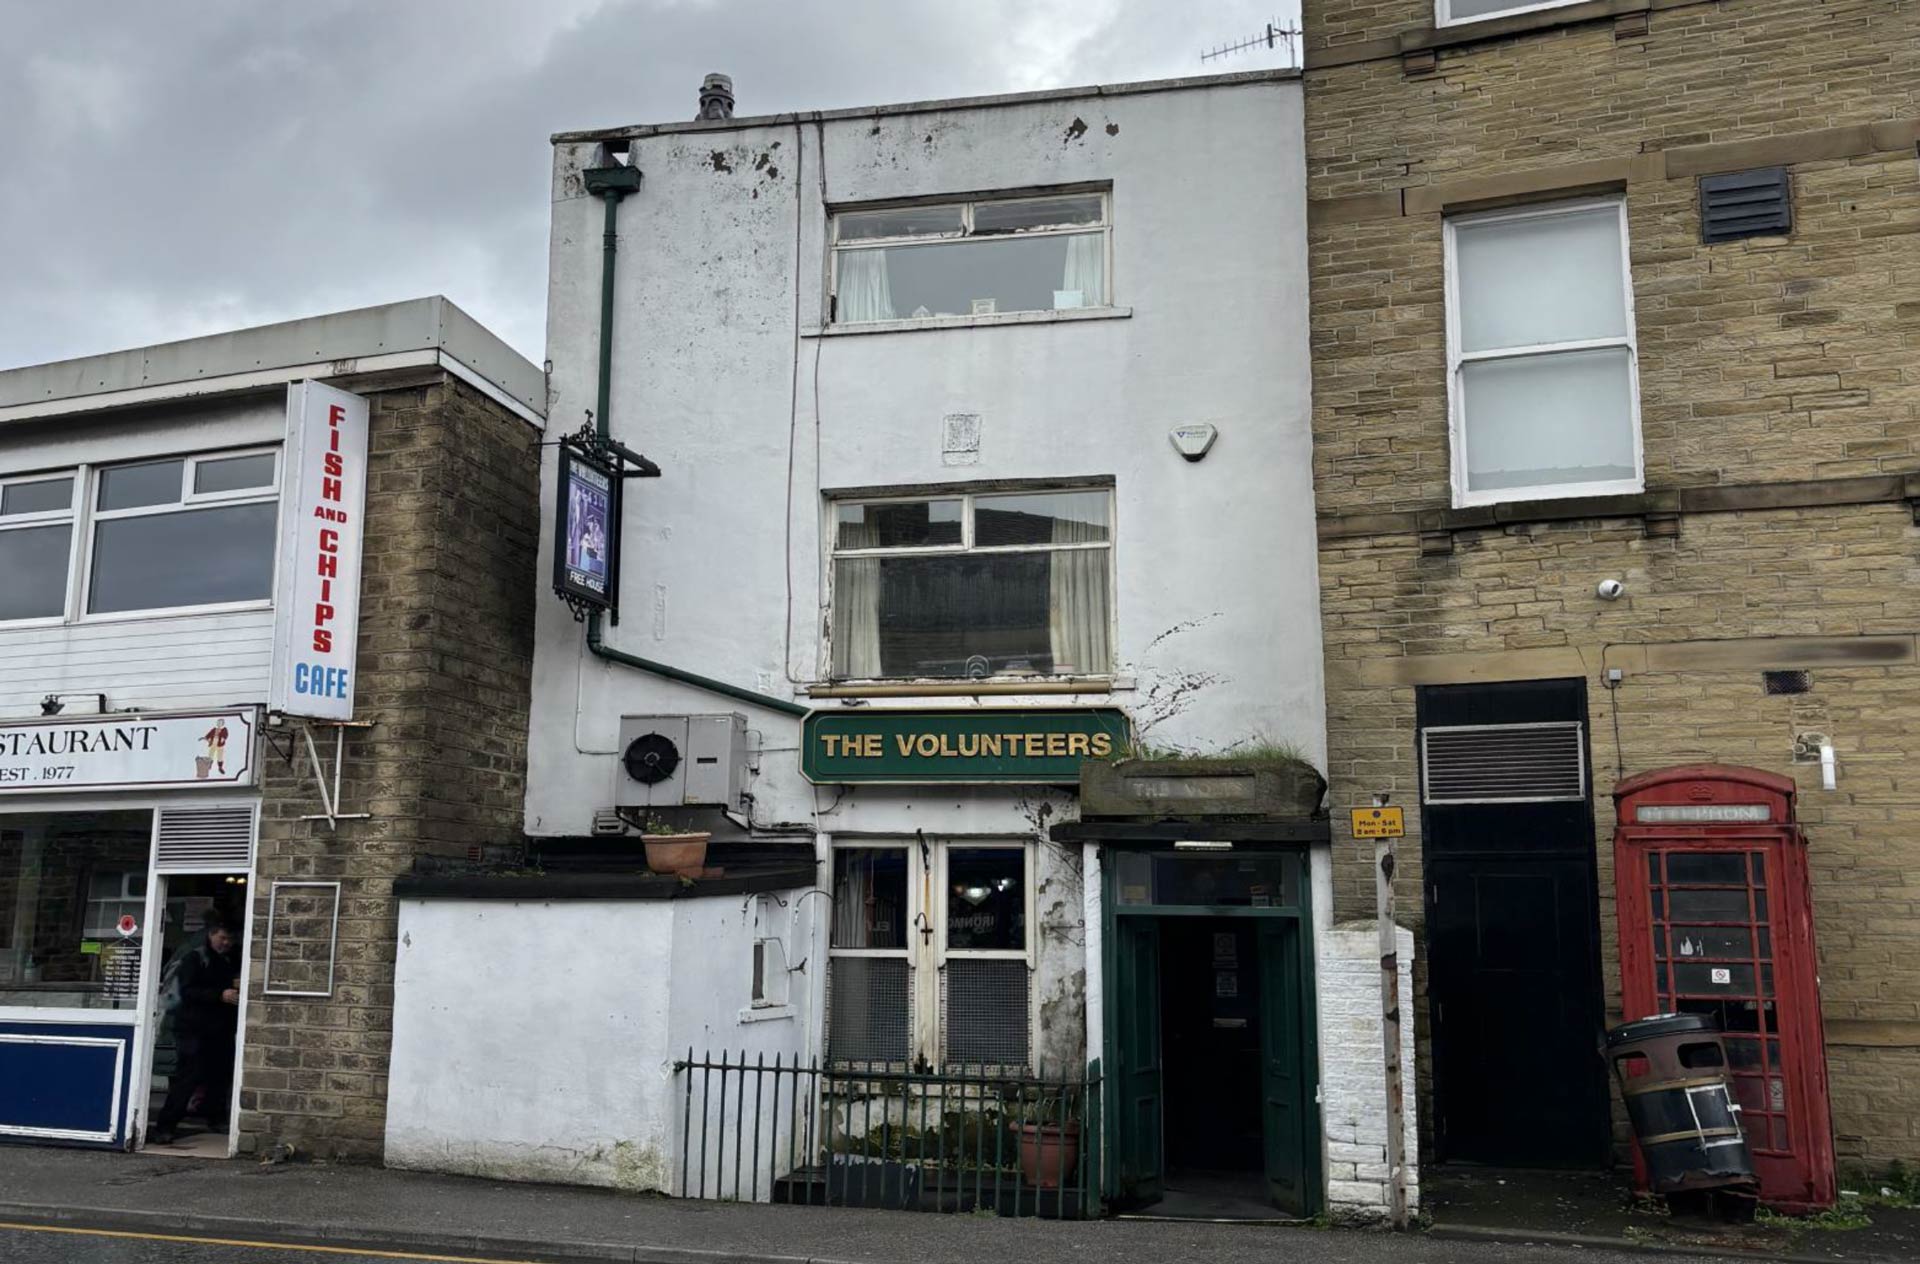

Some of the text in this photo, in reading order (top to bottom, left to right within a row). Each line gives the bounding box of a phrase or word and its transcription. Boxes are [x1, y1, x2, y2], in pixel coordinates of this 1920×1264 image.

[312, 405, 348, 654] FISH AND CHIPS
[569, 570, 605, 594] FREE HOUSE
[294, 662, 349, 700] CAFE
[820, 732, 1113, 757] THE VOLUNTEERS
[42, 766, 76, 781] 1977
